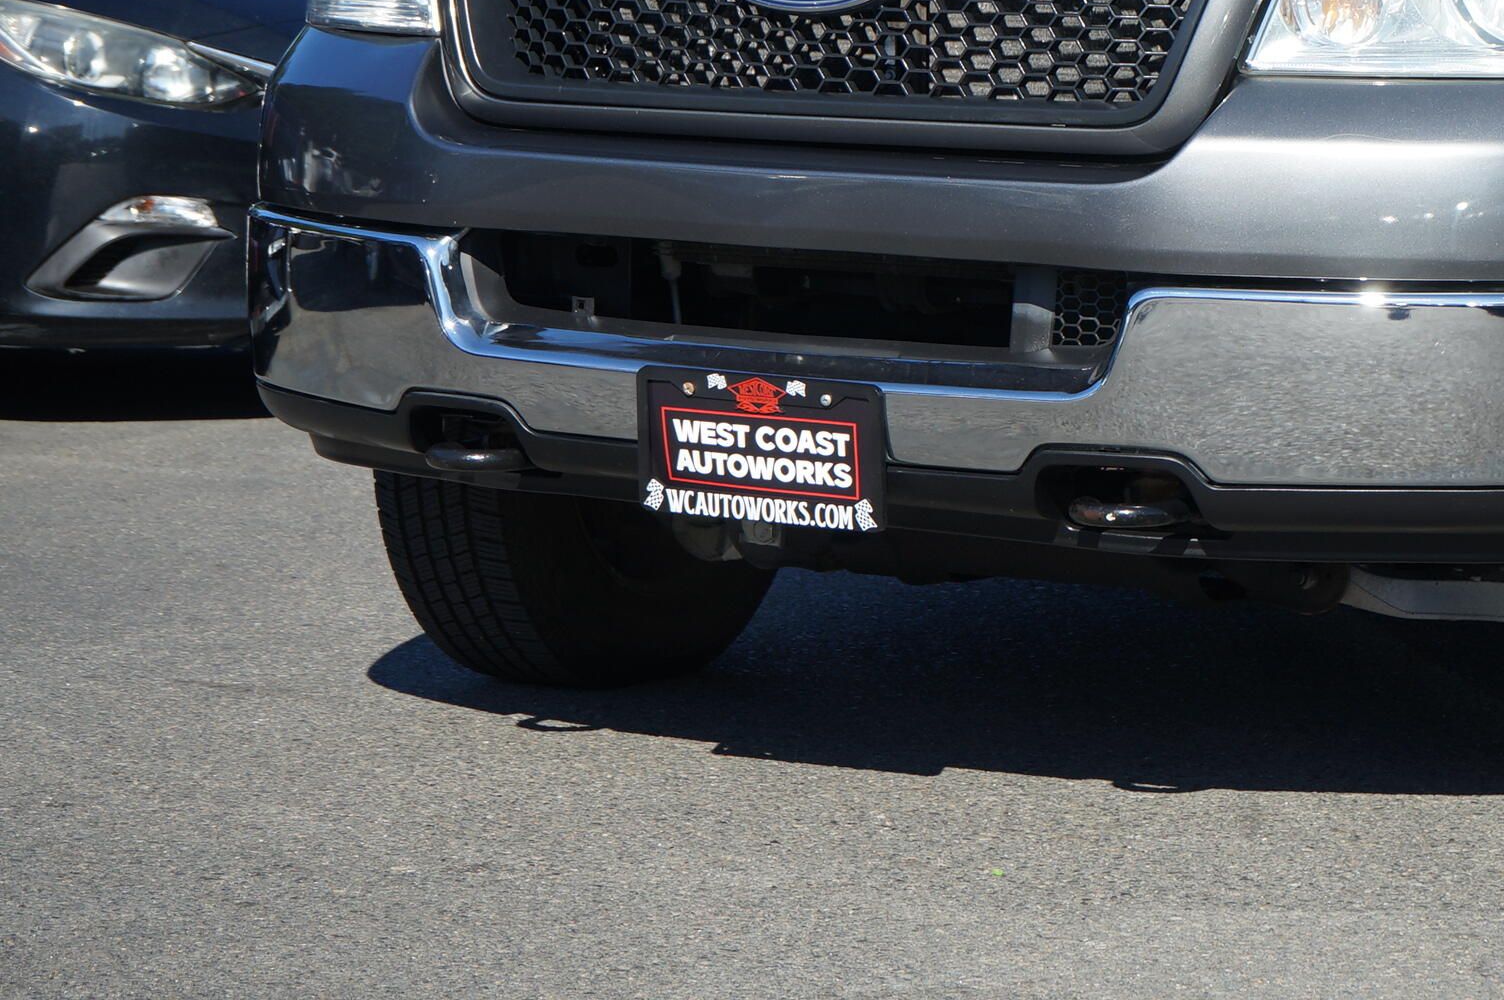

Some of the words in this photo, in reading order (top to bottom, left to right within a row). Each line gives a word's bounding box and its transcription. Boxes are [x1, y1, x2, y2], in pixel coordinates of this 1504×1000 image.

[672, 418, 749, 448] WEST
[755, 426, 850, 457] COAST
[676, 449, 852, 488] AUTOWORKS
[666, 488, 854, 530] WCAUTOWORKS.COM
